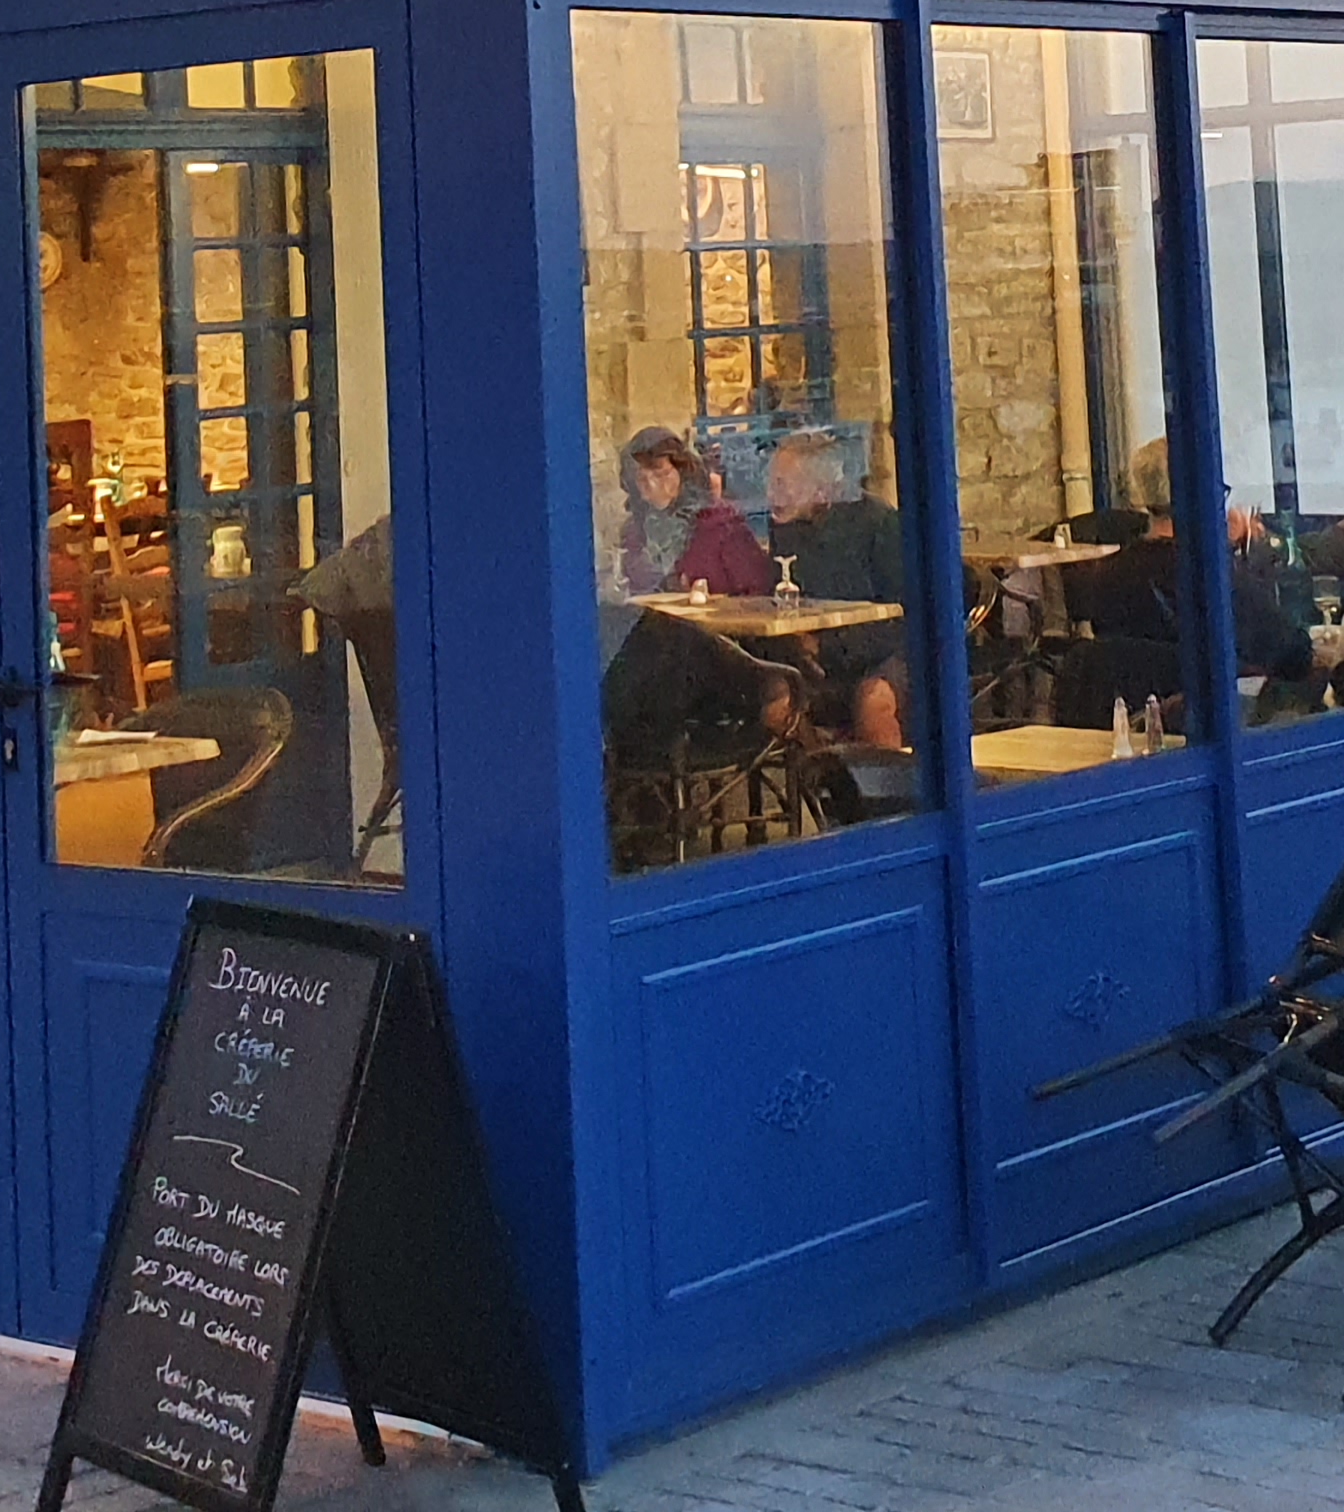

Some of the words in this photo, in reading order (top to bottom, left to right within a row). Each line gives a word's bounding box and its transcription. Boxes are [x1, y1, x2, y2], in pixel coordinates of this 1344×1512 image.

[208, 947, 331, 1006] BIENVENUE
[262, 1006, 286, 1028] LA
[233, 1062, 261, 1085] DU
[208, 1092, 264, 1123] SALLÉ
[152, 1176, 190, 1209] PORT
[192, 1195, 221, 1218] DU
[225, 1203, 286, 1239] MASQUE
[131, 1255, 160, 1277] DES
[154, 1226, 249, 1272] OBLIGATOIRE
[254, 1259, 289, 1287] LORS
[127, 1290, 171, 1318] DANS
[179, 1309, 196, 1329] LA
